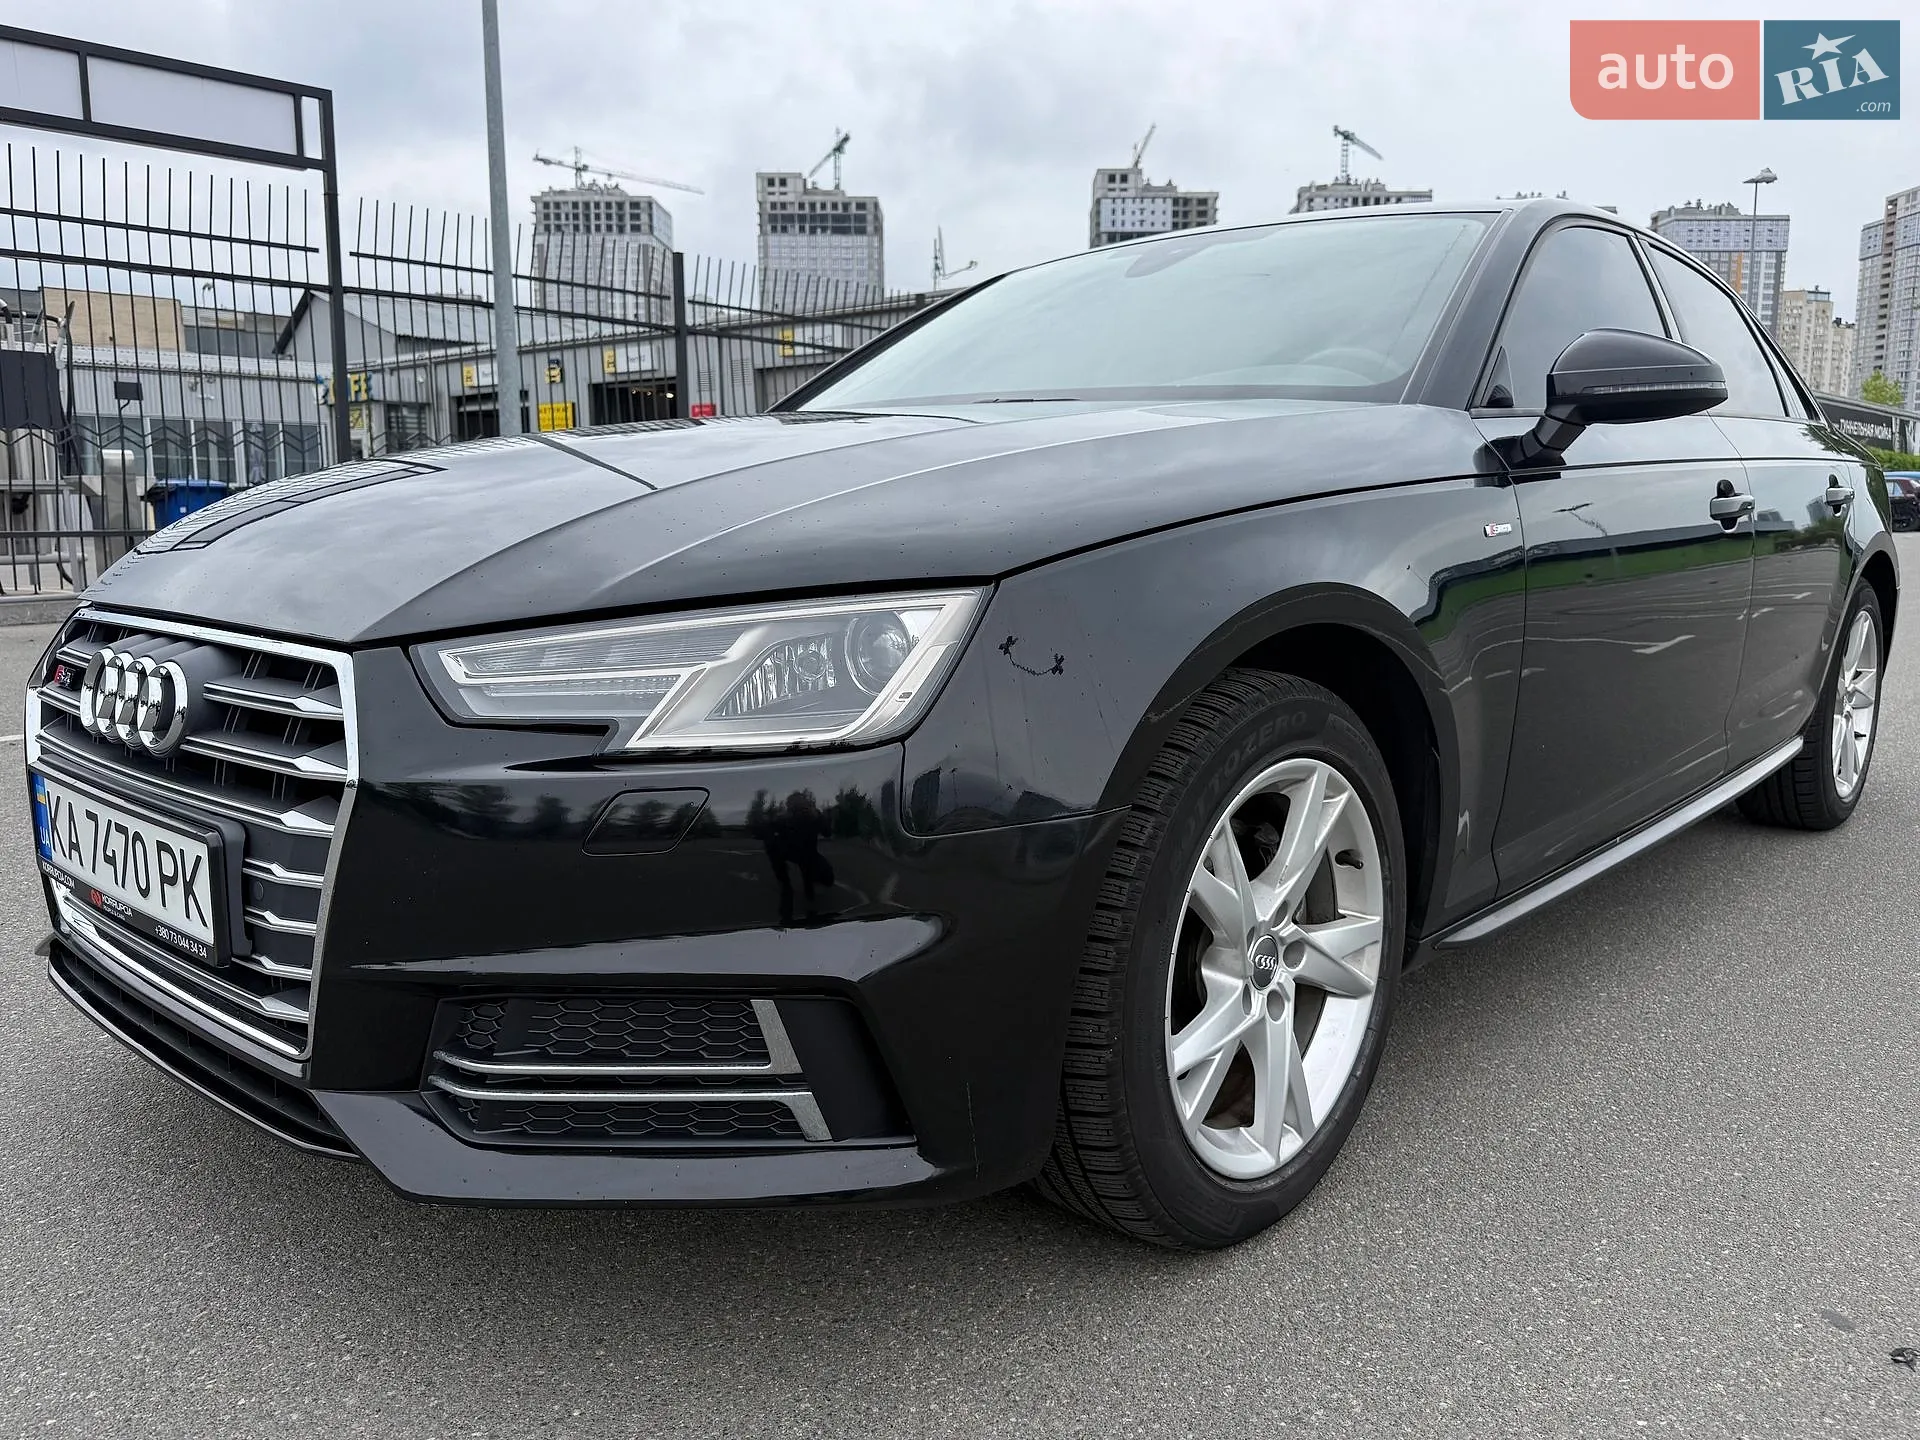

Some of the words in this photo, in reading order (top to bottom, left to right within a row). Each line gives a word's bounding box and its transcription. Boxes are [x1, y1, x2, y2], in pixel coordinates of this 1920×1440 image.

[40, 826, 51, 849] UA
[46, 790, 84, 867] KA
[85, 808, 151, 899] 7470
[155, 839, 208, 928] PK
[155, 925, 169, 940] +380
[169, 931, 178, 945] 73
[178, 936, 189, 950] 044
[189, 940, 198, 955] 34
[199, 945, 208, 959] 34
